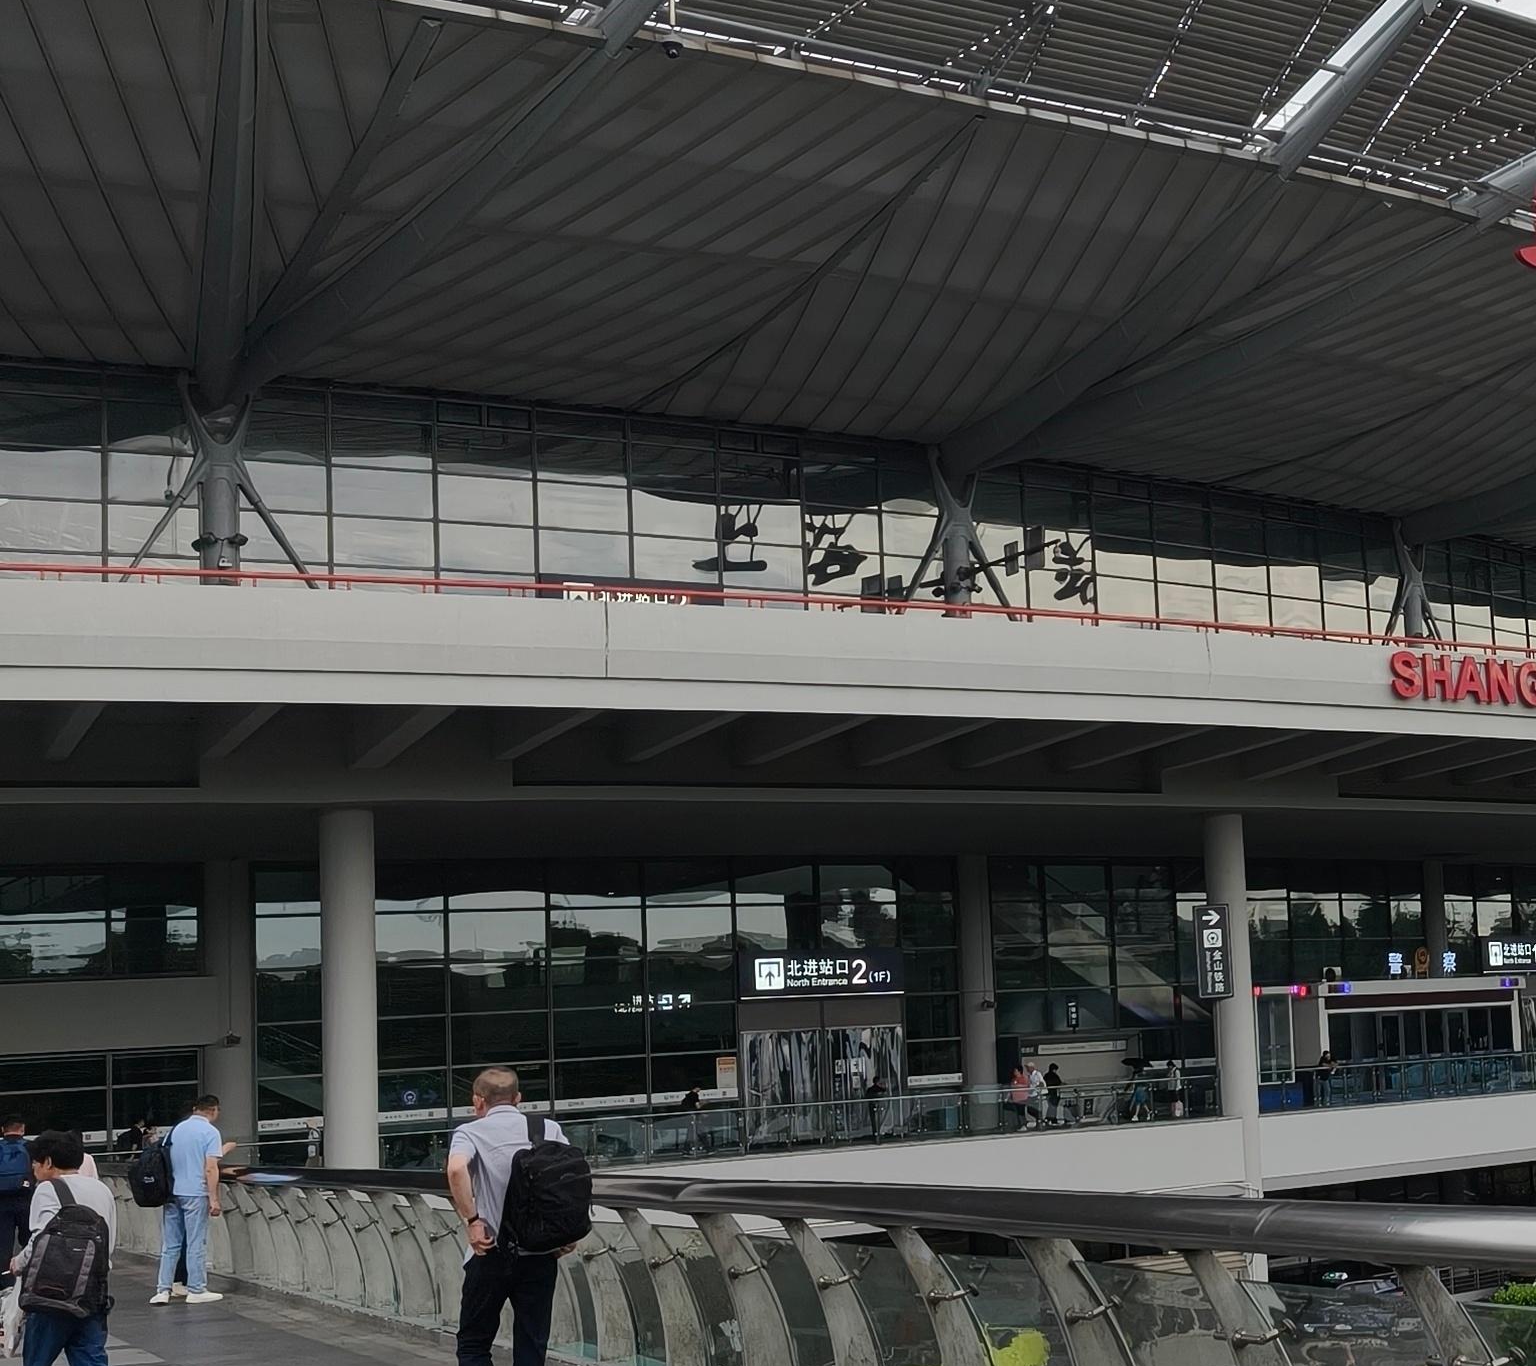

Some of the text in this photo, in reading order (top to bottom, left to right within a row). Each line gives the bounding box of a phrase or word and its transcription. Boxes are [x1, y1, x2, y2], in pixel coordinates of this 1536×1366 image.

[787, 958, 849, 977] 北进站口
[868, 970, 891, 983] (1F)
[786, 976, 849, 987] North Entrance
